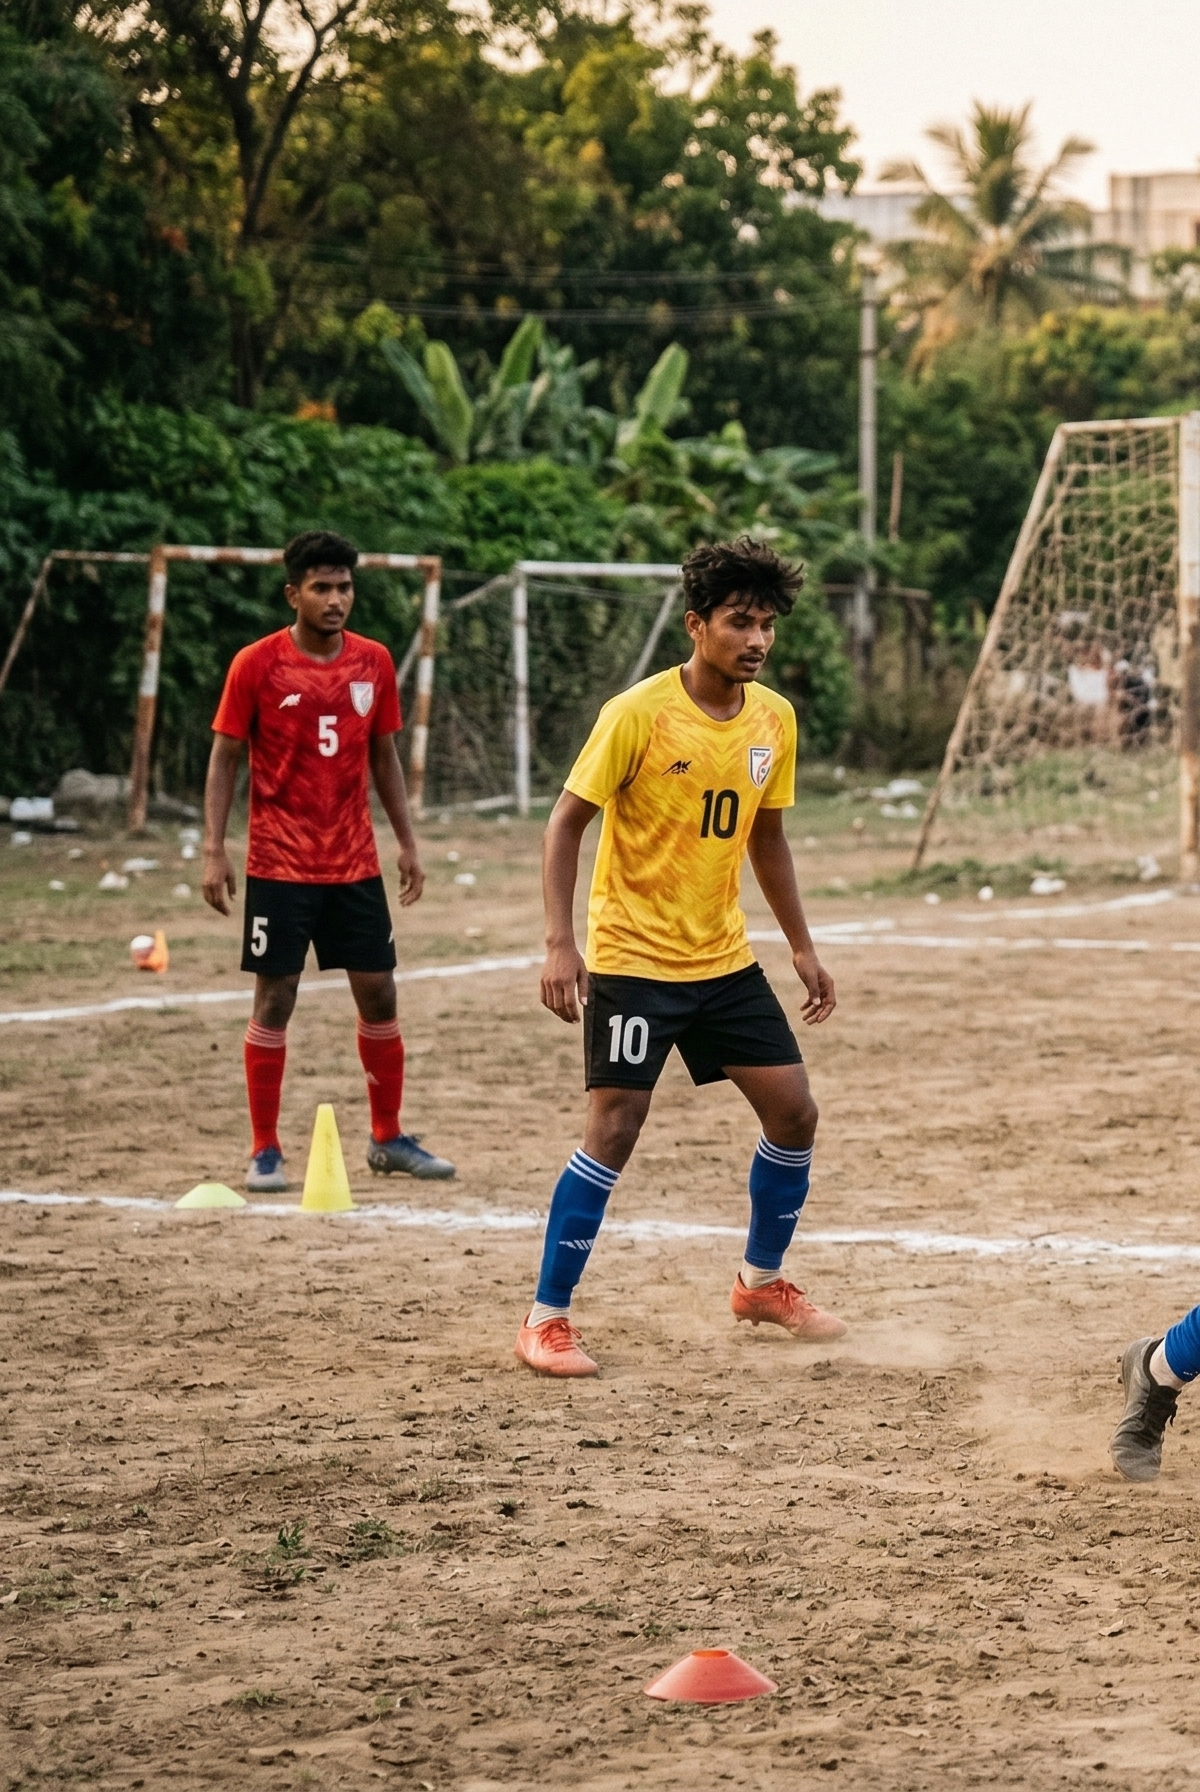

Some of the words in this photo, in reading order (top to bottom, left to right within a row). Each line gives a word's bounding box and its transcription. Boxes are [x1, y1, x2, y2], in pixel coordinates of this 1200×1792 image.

[318, 715, 339, 757] 5
[701, 788, 740, 840] 10
[250, 916, 268, 957] 5
[608, 1014, 649, 1065] 10
